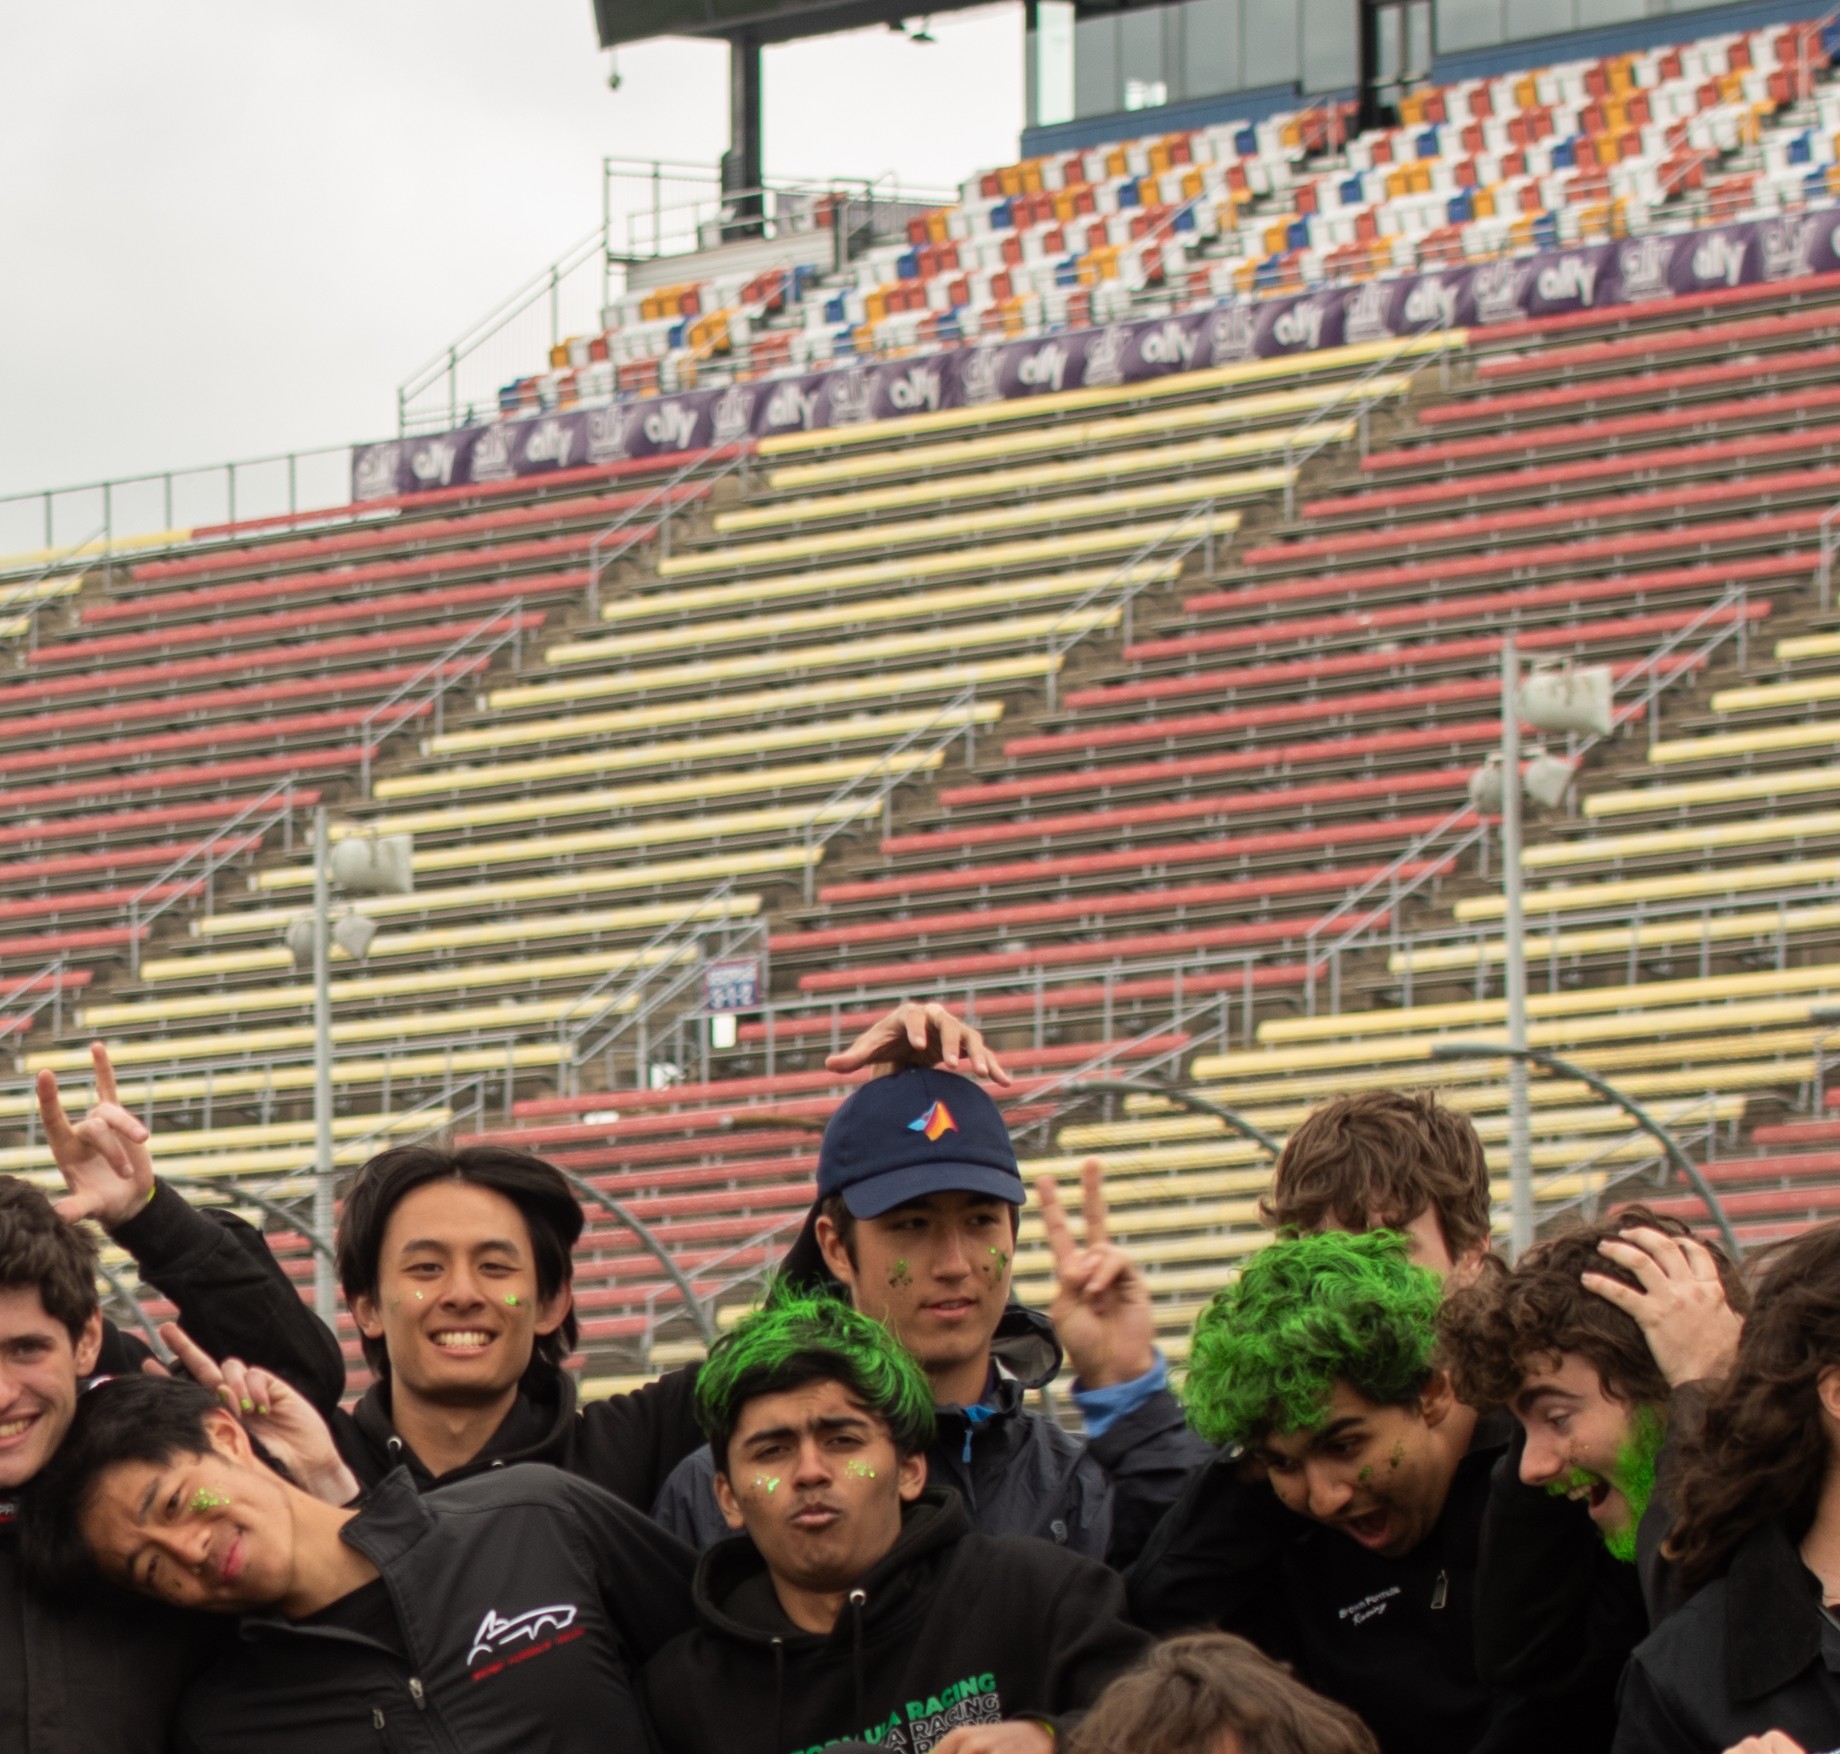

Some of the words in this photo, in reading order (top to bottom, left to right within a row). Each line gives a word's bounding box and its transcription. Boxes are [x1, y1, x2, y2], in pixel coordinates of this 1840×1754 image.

[1538, 257, 1596, 306] ally
[1693, 235, 1747, 286] ally
[1274, 301, 1324, 349] ally
[1405, 280, 1456, 325] ally
[1018, 346, 1069, 390] ally
[1142, 323, 1196, 370] ally
[765, 384, 819, 429] ally
[890, 366, 940, 412] ally
[527, 421, 572, 466] ally
[645, 403, 697, 449] ally
[412, 440, 456, 484] ally
[905, 1672, 997, 1724] RACING
